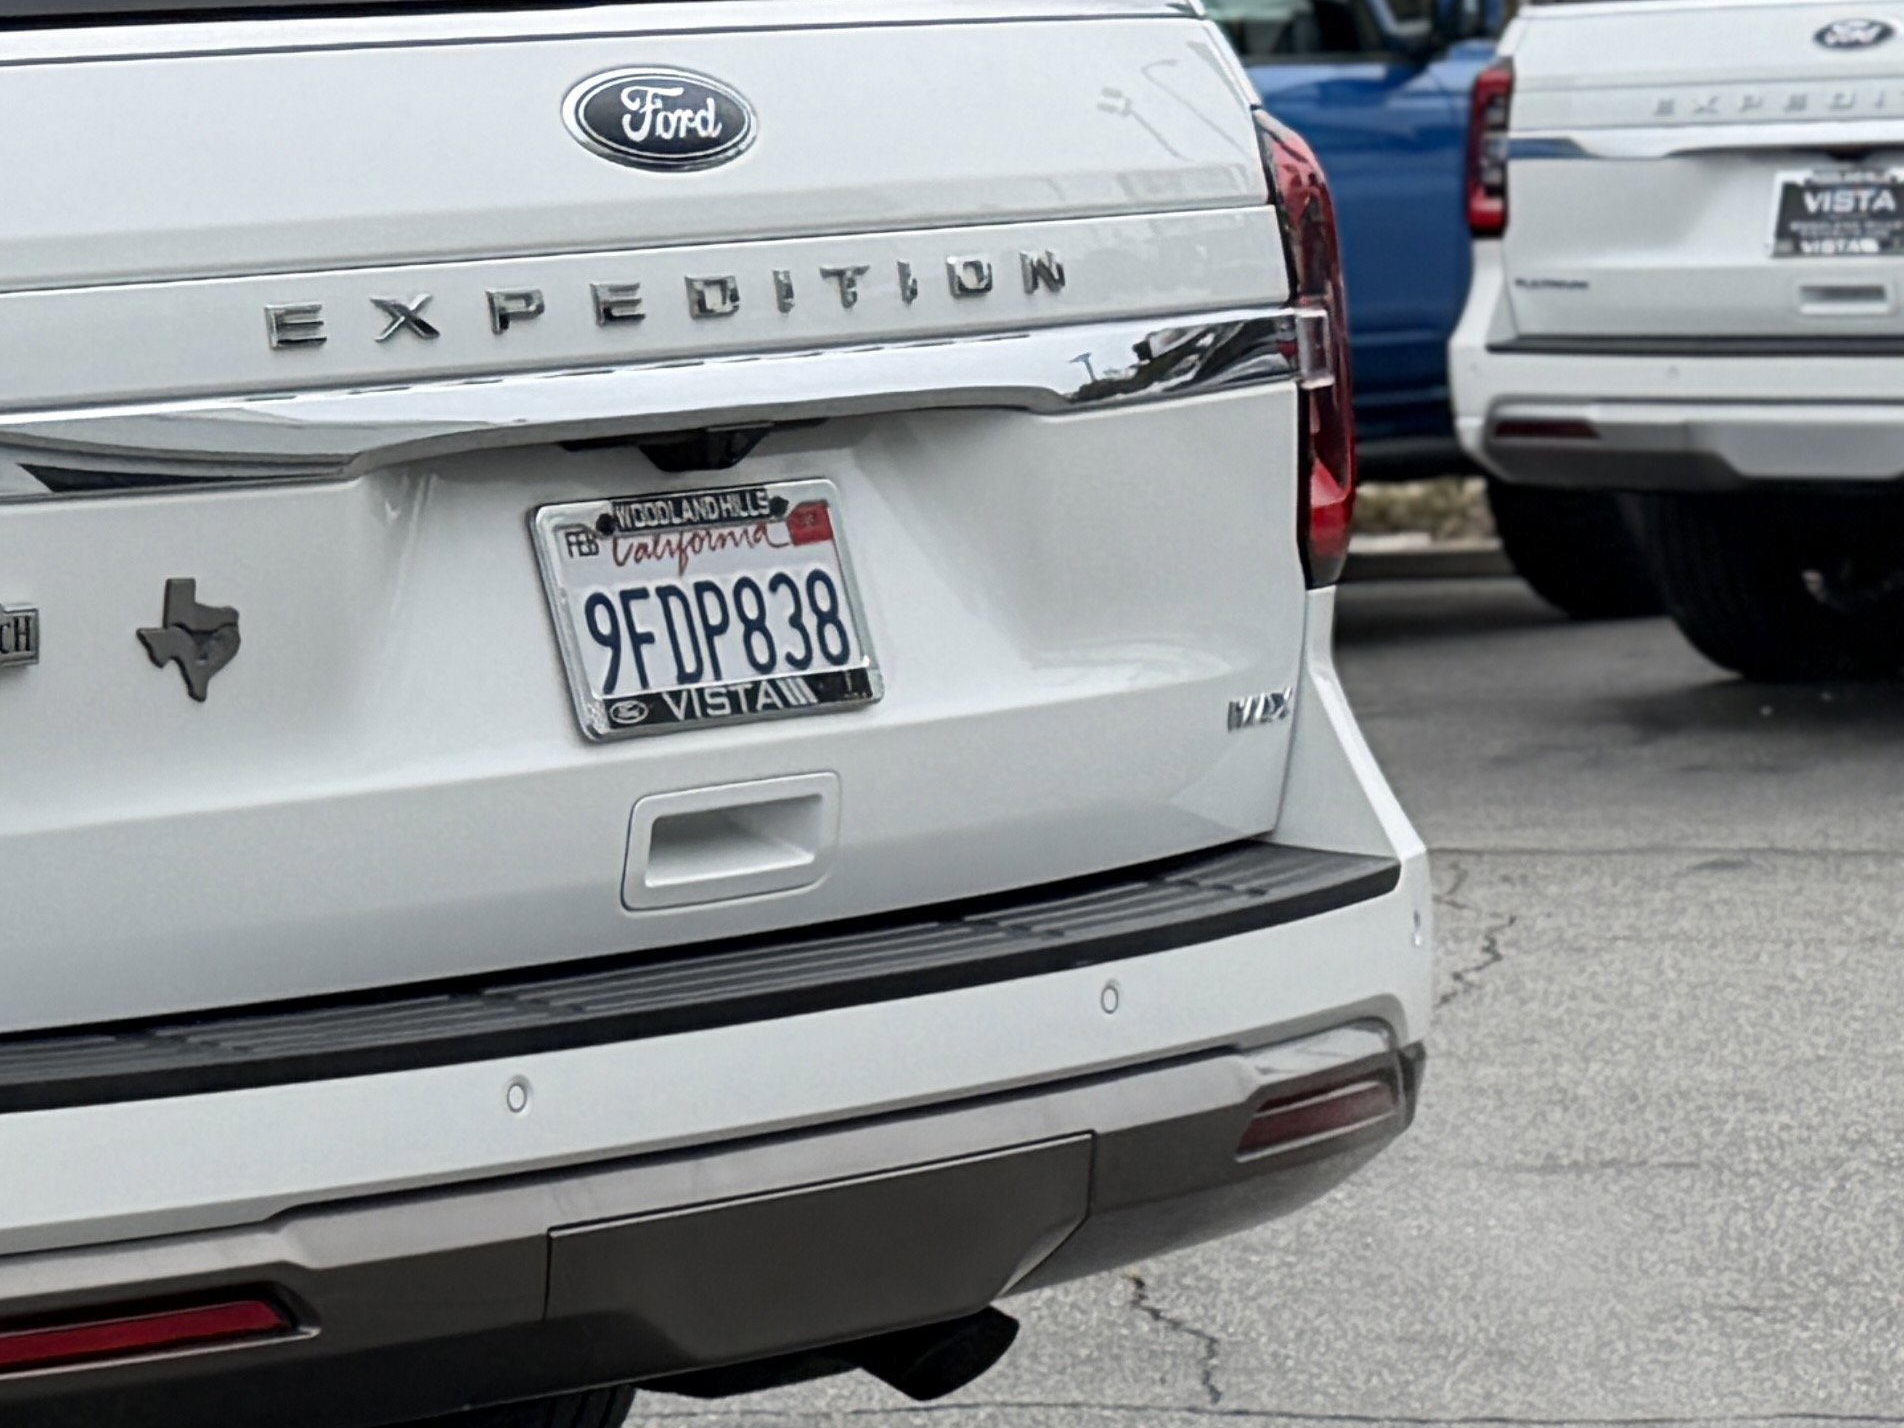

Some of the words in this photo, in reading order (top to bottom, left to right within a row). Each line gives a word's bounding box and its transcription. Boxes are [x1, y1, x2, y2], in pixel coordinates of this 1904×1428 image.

[620, 85, 723, 143] Ford
[1654, 87, 1904, 118] EXPEDI
[1803, 188, 1897, 214] VISTA
[264, 248, 1068, 351] EXPEDITION
[615, 494, 719, 529] WOODLAND
[719, 489, 769, 519] HILLS
[613, 522, 789, 577] California
[583, 568, 851, 694] 9FDP838
[661, 676, 785, 721] VISTA
